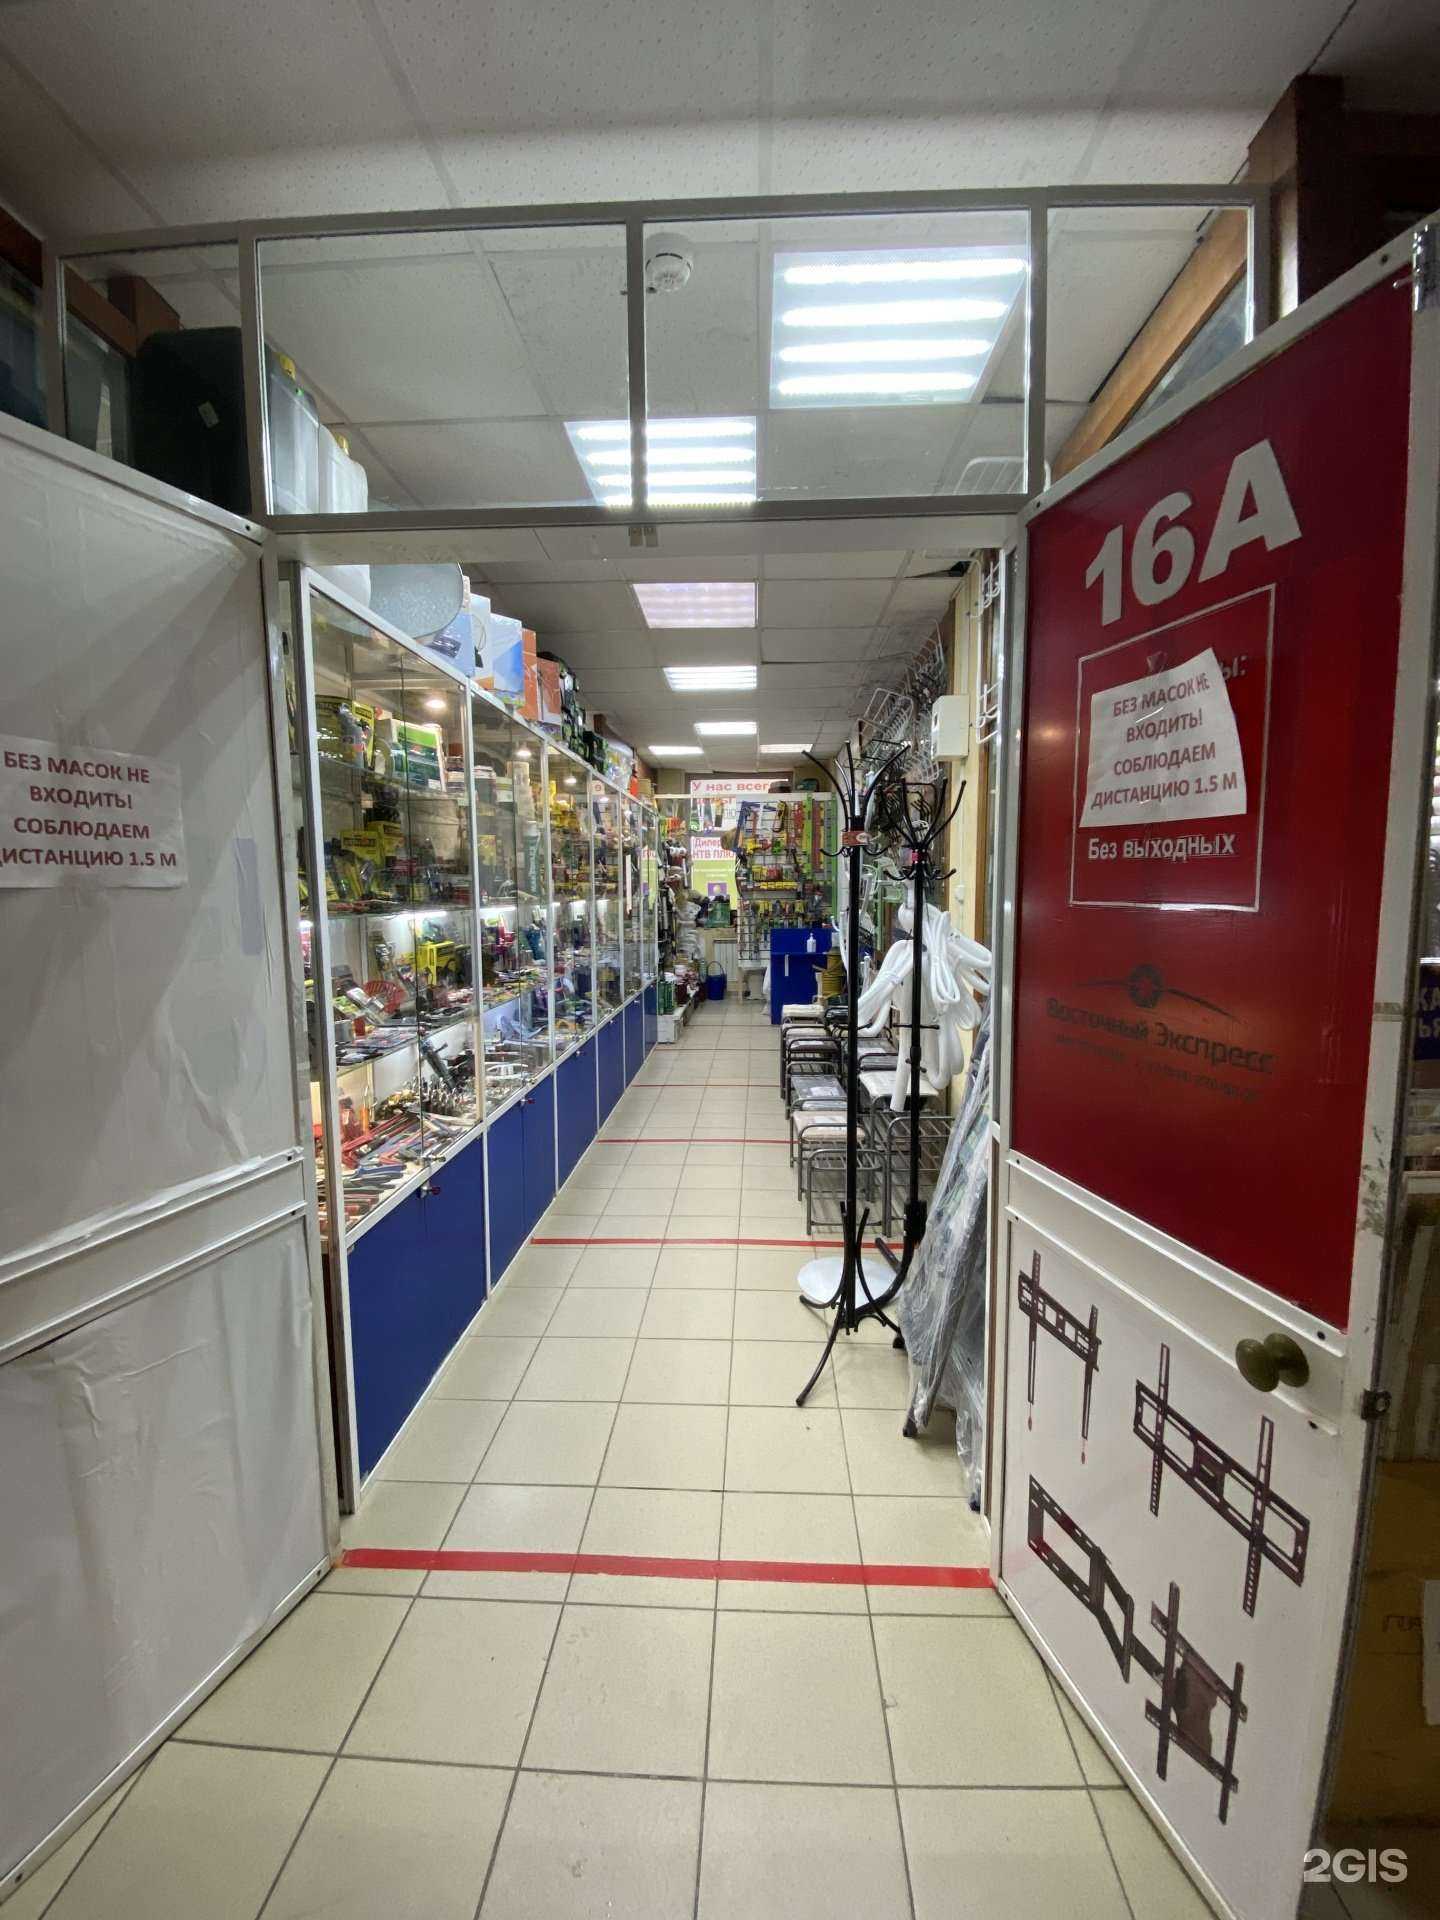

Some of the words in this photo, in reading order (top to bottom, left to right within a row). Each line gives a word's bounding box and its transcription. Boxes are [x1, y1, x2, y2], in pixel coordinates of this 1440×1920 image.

[1113, 697, 1137, 717] БЕЗ
[1142, 679, 1195, 710] МАСОК
[1196, 672, 1210, 693] НЕ
[1126, 708, 1203, 742] ВХОДИТЬ!
[4, 751, 41, 772] БЕЗ
[47, 757, 123, 781] МАСОК
[127, 767, 150, 784] НЕ
[1114, 741, 1216, 776] СОБЛЮДАЕМ
[30, 785, 133, 809] ВХОДИТЬ!
[706, 782, 732, 791] нас
[736, 782, 769, 791] всег
[1090, 780, 1190, 810] ДИСТАНЦИЮ
[1194, 775, 1218, 795] 1.5
[1222, 772, 1239, 790] М
[14, 817, 151, 840] СОБЛЮДАЕМ
[0, 848, 124, 868] ИСТАНЦИЮ
[129, 852, 155, 867] 1.5
[160, 852, 177, 867] М
[1088, 837, 1117, 860] Без
[1123, 833, 1236, 862] выходных
[1153, 1022, 1276, 1074] Экспресс
